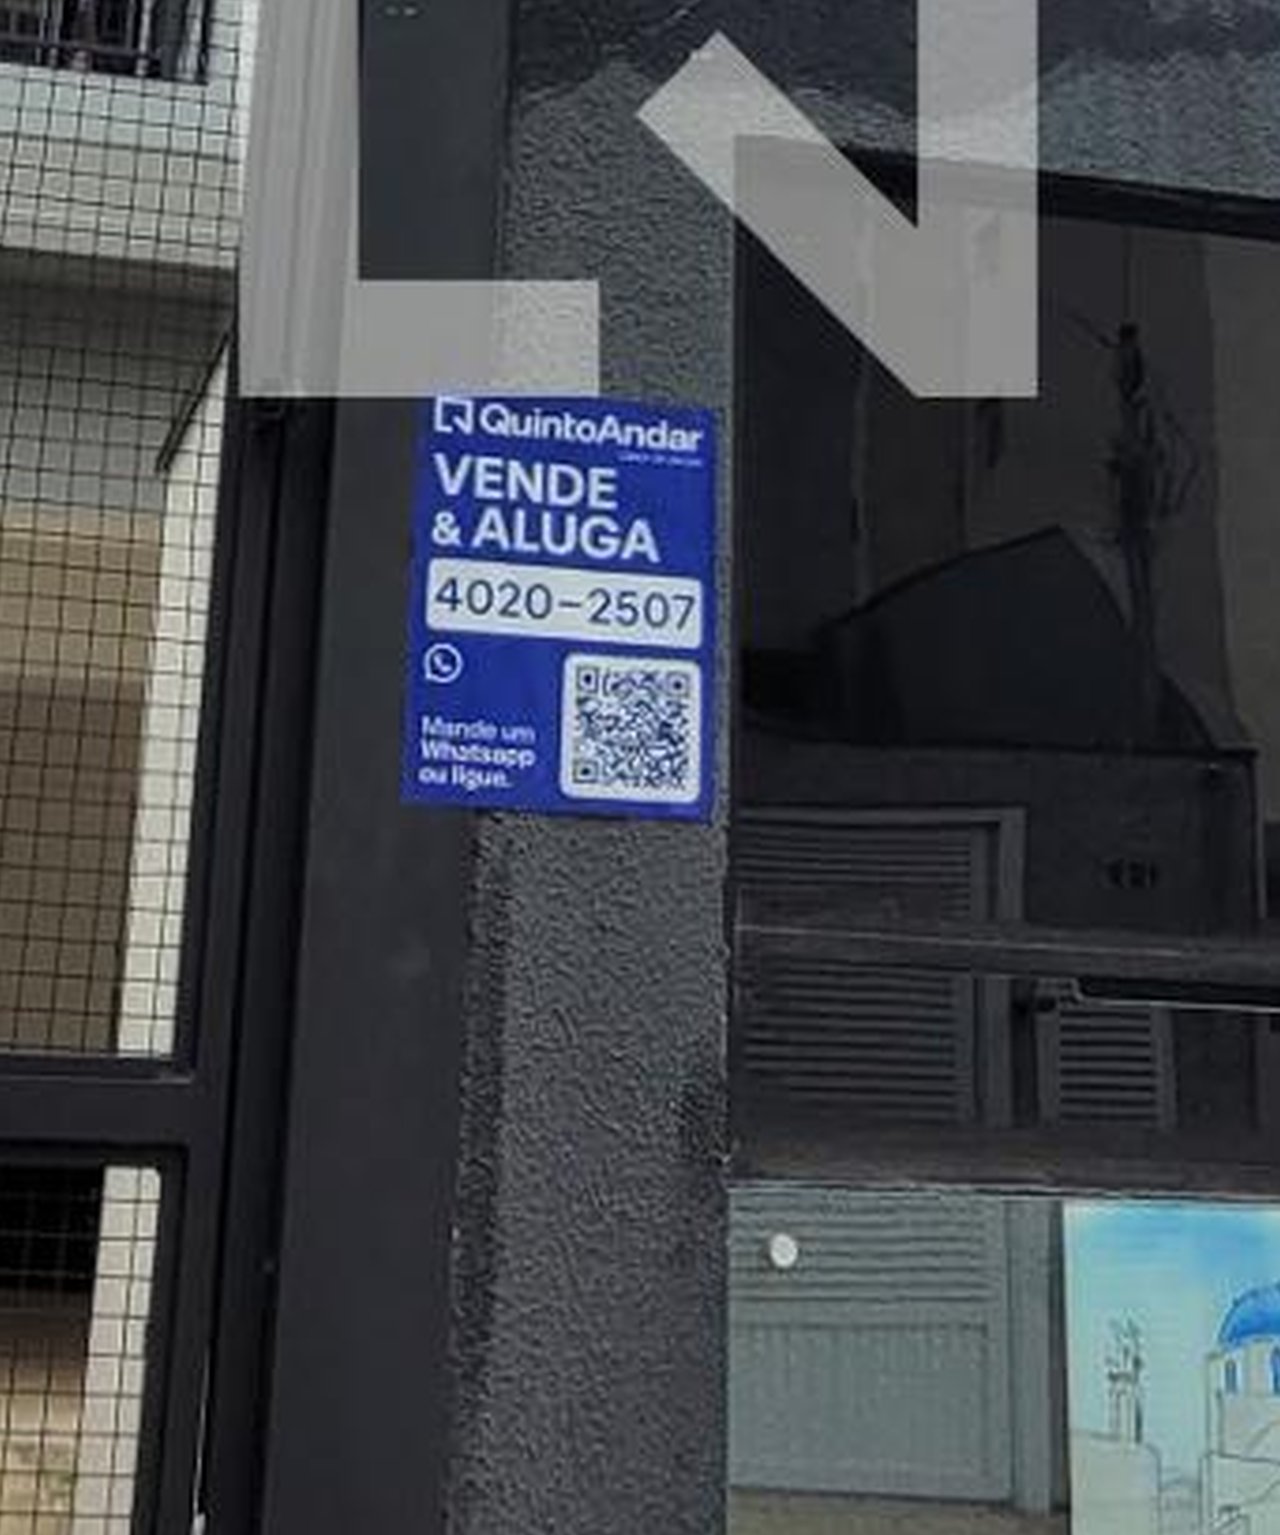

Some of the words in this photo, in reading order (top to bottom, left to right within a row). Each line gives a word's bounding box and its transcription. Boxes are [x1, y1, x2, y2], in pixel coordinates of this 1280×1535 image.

[480, 402, 703, 452] QuintoAndar
[432, 453, 619, 509] VENDE
[432, 510, 461, 547] &
[472, 507, 660, 563] ALUGA
[434, 577, 696, 629] 4020-2507
[501, 726, 536, 745] um
[418, 767, 447, 784] ou
